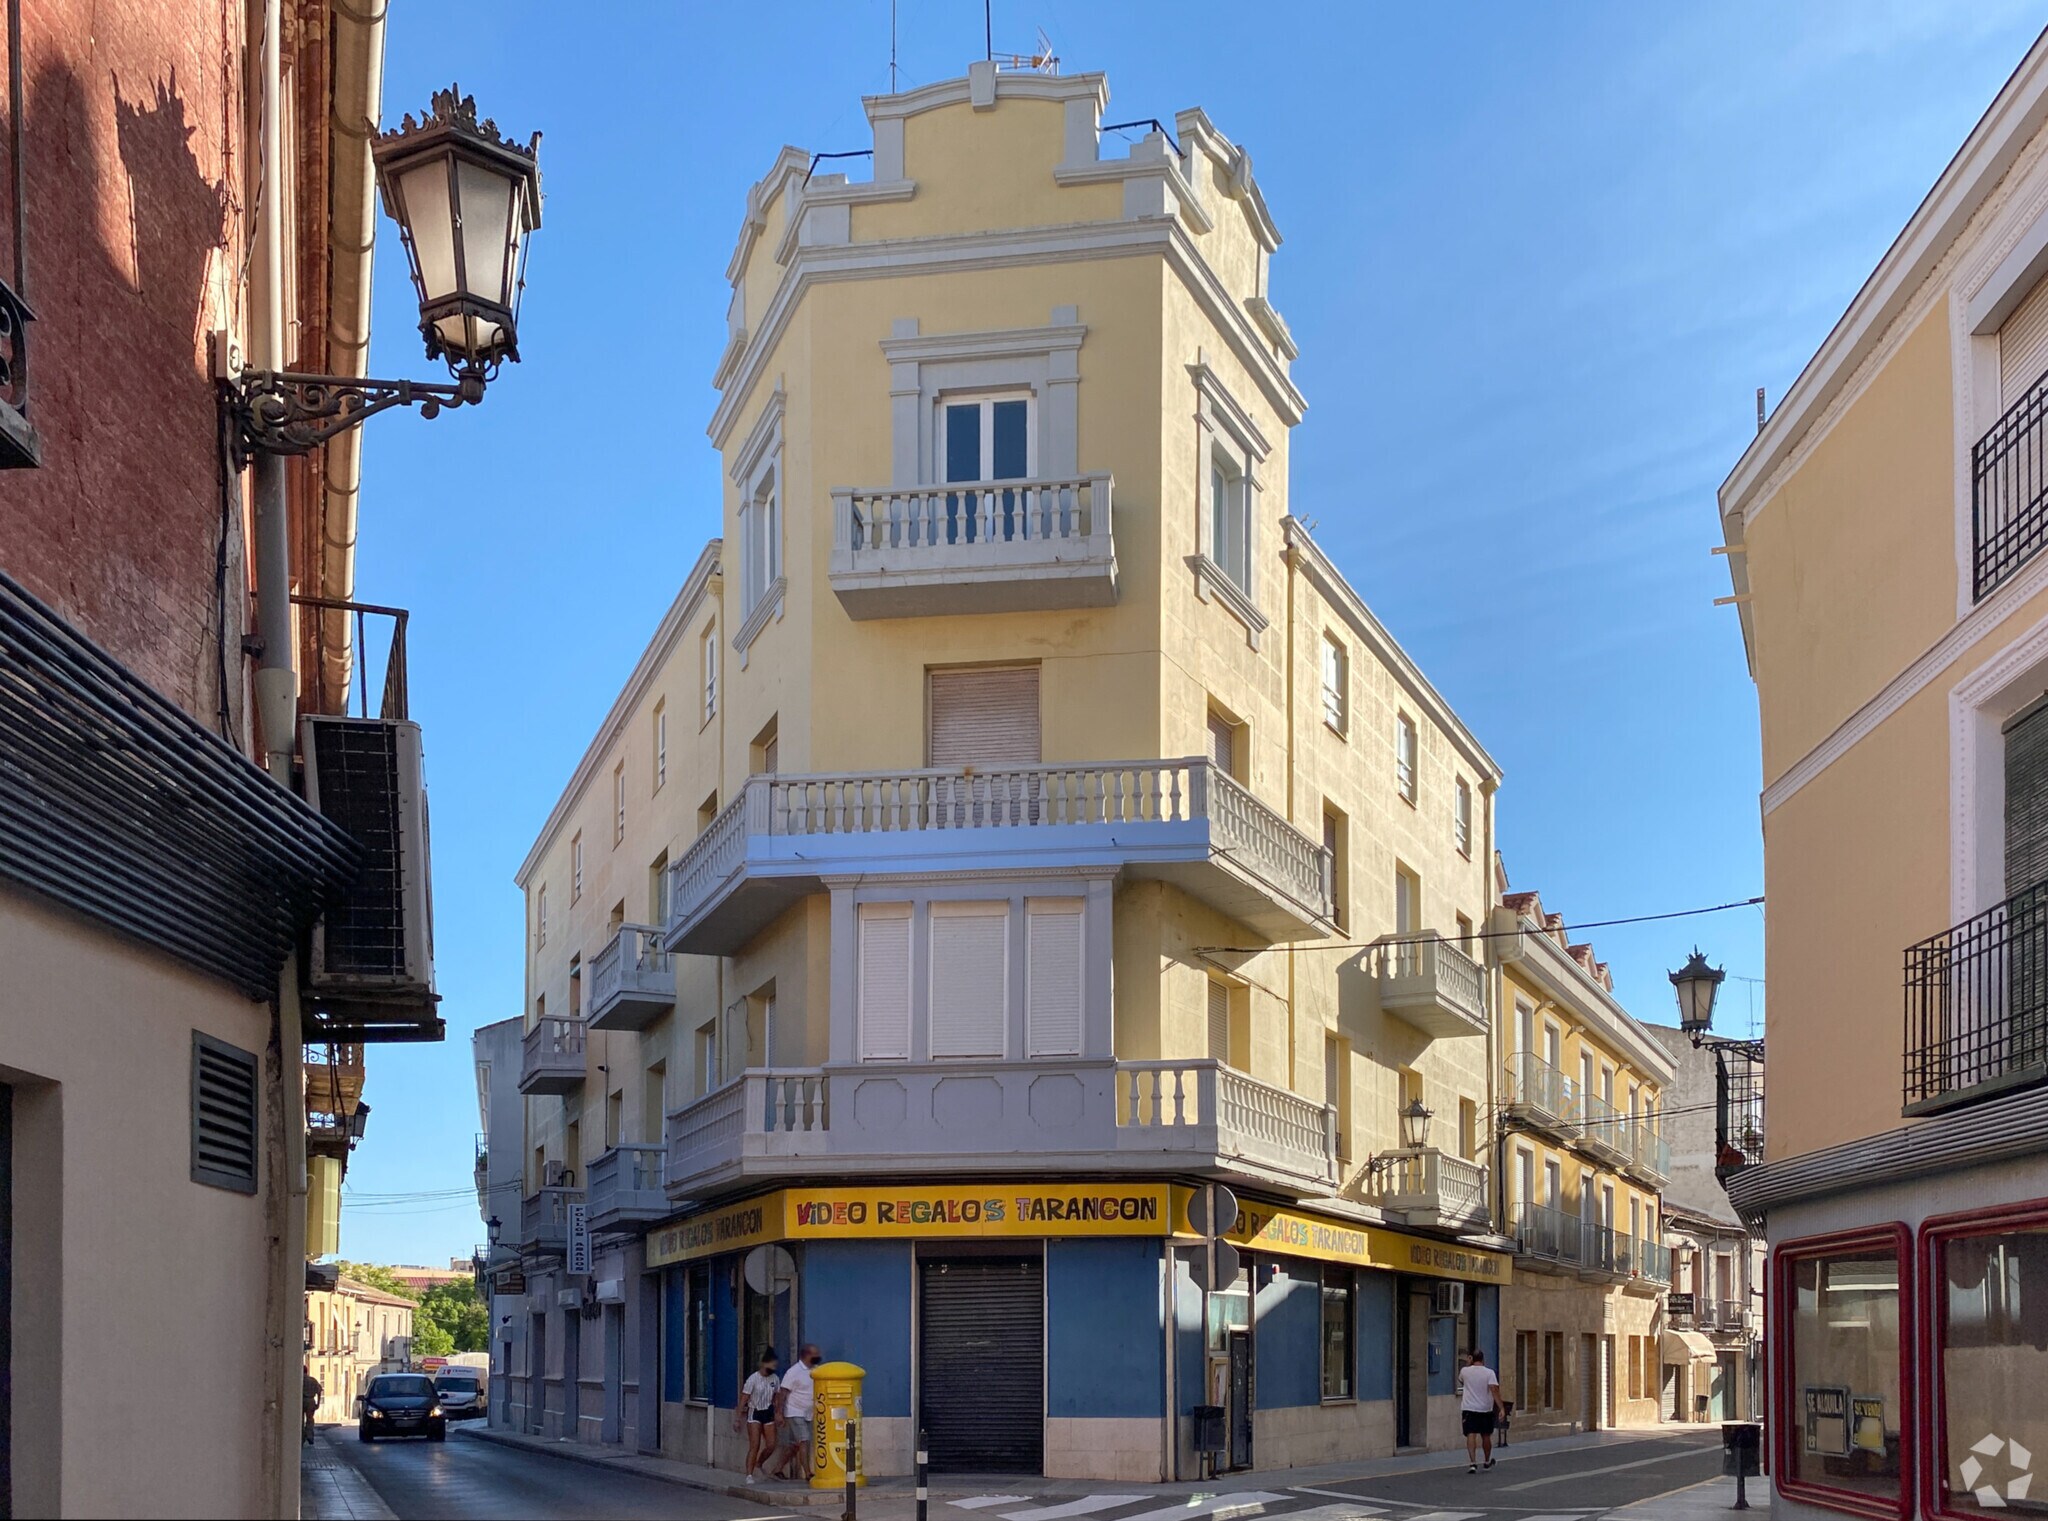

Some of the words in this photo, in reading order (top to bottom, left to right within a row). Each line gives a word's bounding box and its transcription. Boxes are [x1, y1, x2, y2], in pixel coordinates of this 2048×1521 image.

[575, 1207, 584, 1237] POLLOS
[716, 1206, 763, 1241] TARANCON
[877, 1199, 1005, 1224] REGALOS
[1016, 1197, 1157, 1222] TARANCON
[1251, 1212, 1308, 1246] REGALOS
[1312, 1225, 1365, 1255] TARANCON
[575, 1242, 585, 1271] ASADOS
[1807, 1393, 1816, 1413] SE
[1817, 1393, 1844, 1414] ALQUILA
[816, 1393, 827, 1469] CORREOS
